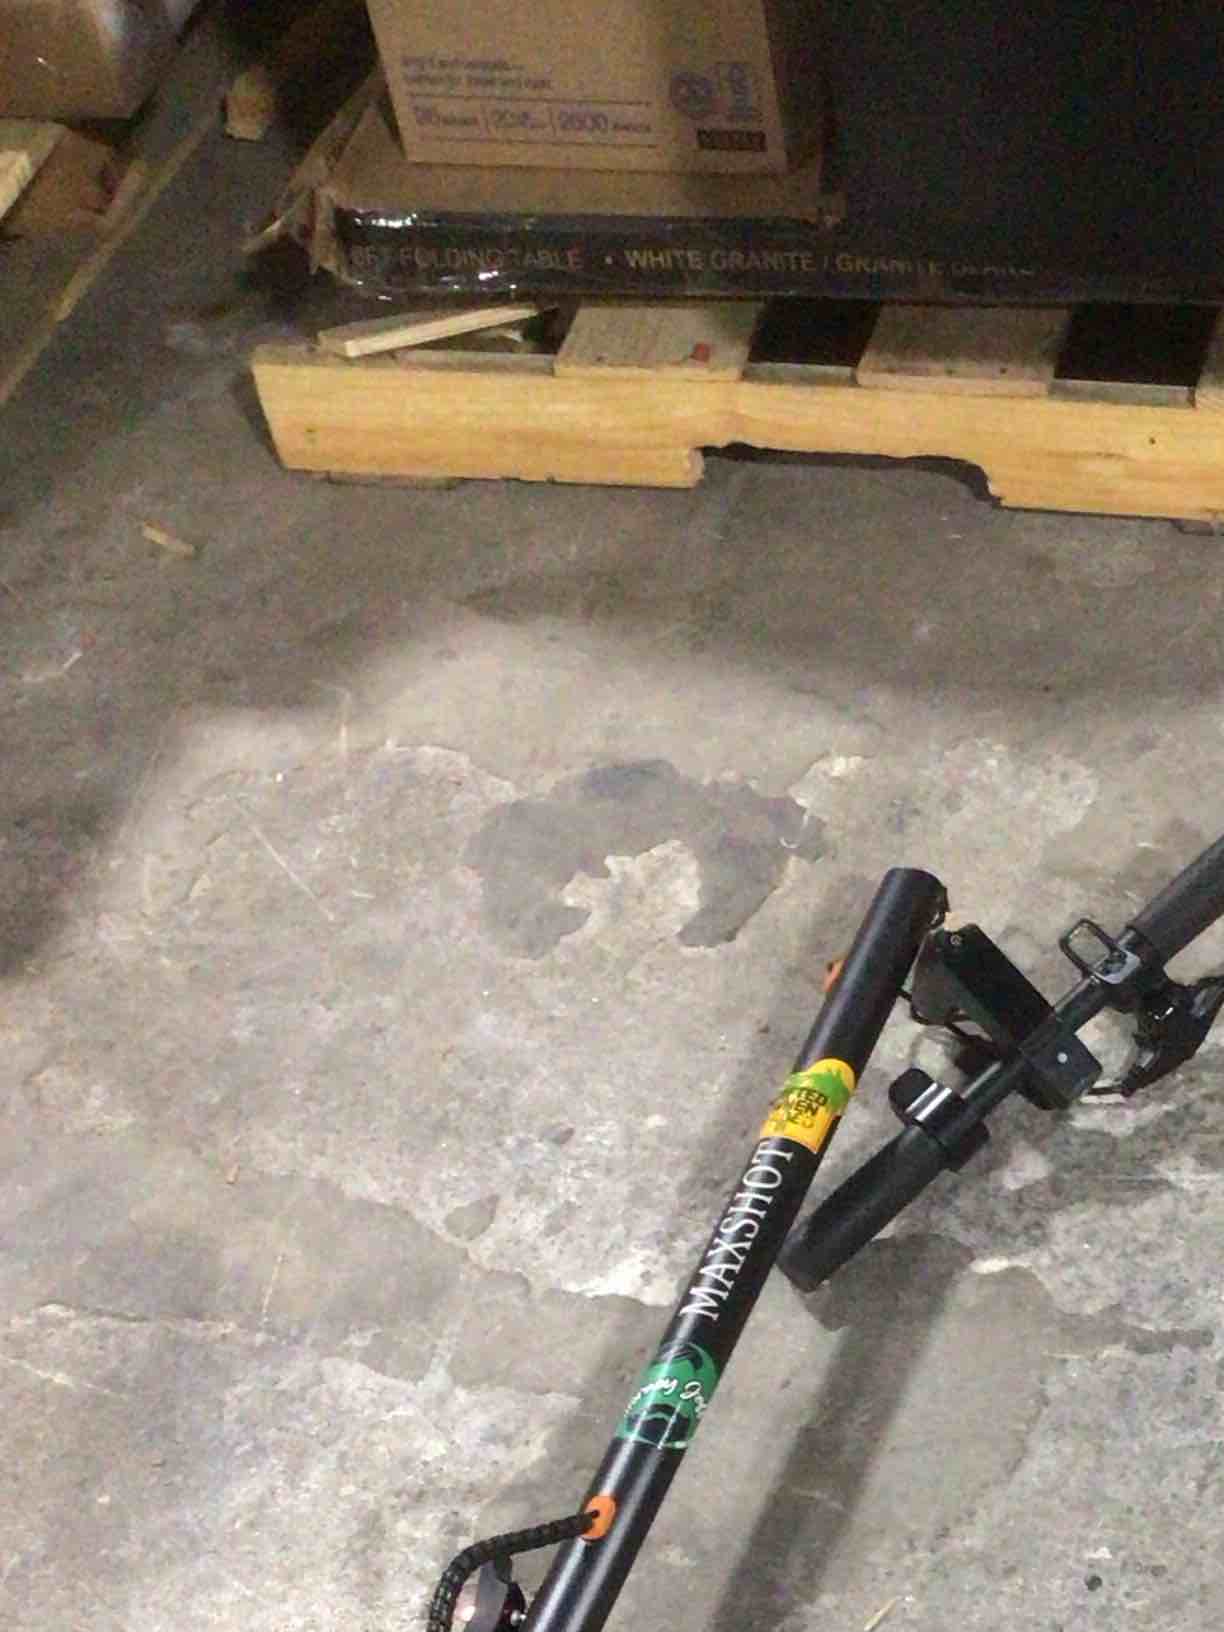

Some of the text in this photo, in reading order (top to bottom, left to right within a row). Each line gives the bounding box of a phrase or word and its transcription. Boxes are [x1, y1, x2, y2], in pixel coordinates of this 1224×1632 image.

[624, 248, 704, 271] WHITE
[708, 249, 816, 273] GRANITE
[679, 1140, 794, 1321] MAXSHOT
